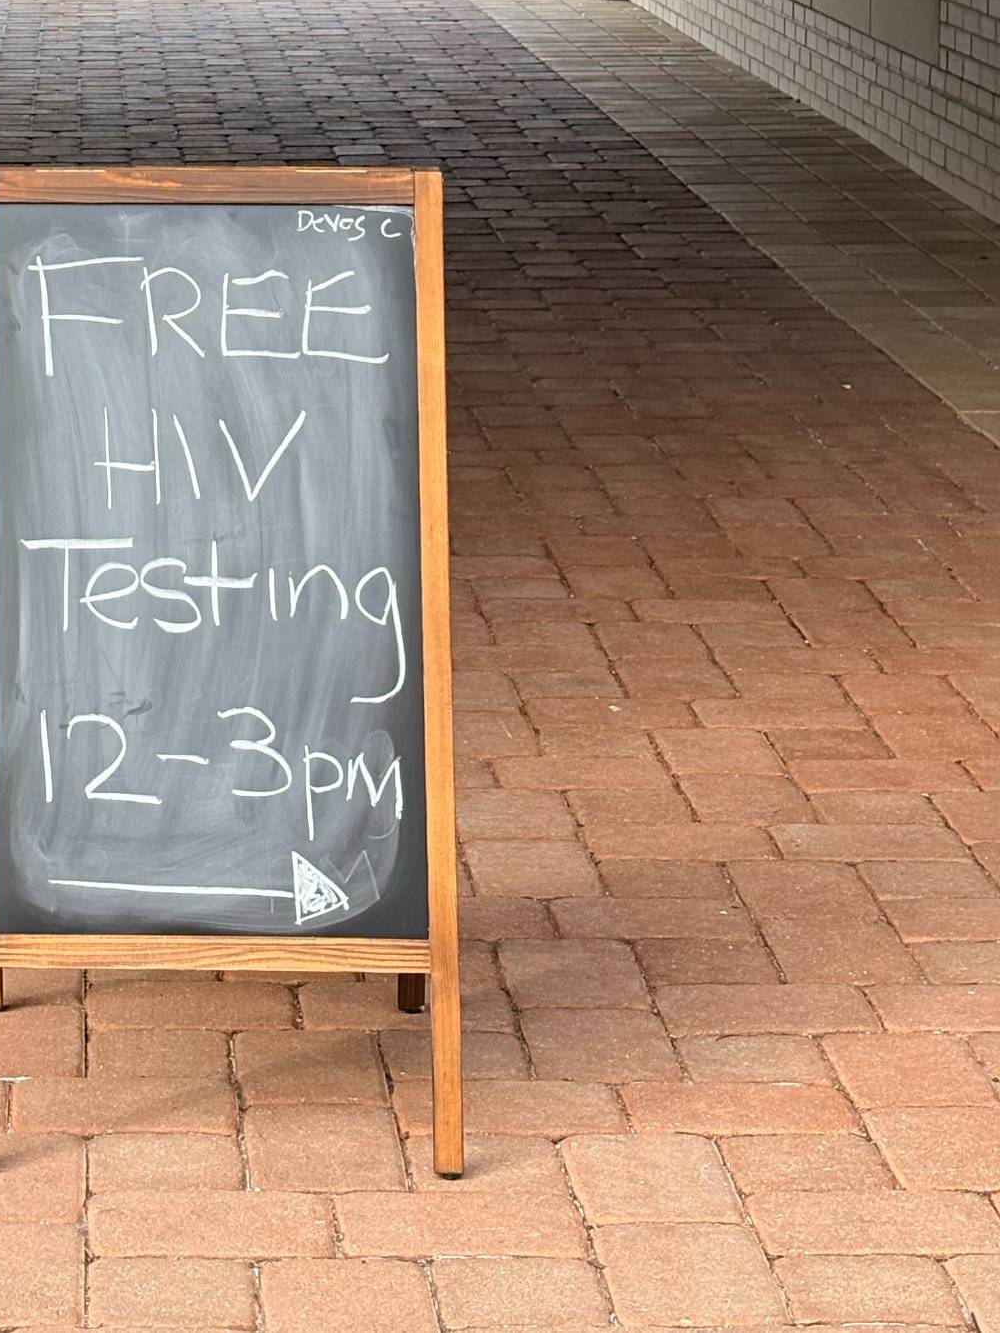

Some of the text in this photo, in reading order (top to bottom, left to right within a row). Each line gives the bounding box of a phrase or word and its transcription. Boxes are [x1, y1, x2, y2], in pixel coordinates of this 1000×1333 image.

[27, 255, 390, 377] FREE
[93, 405, 307, 510] HIV
[19, 537, 406, 703] Testing
